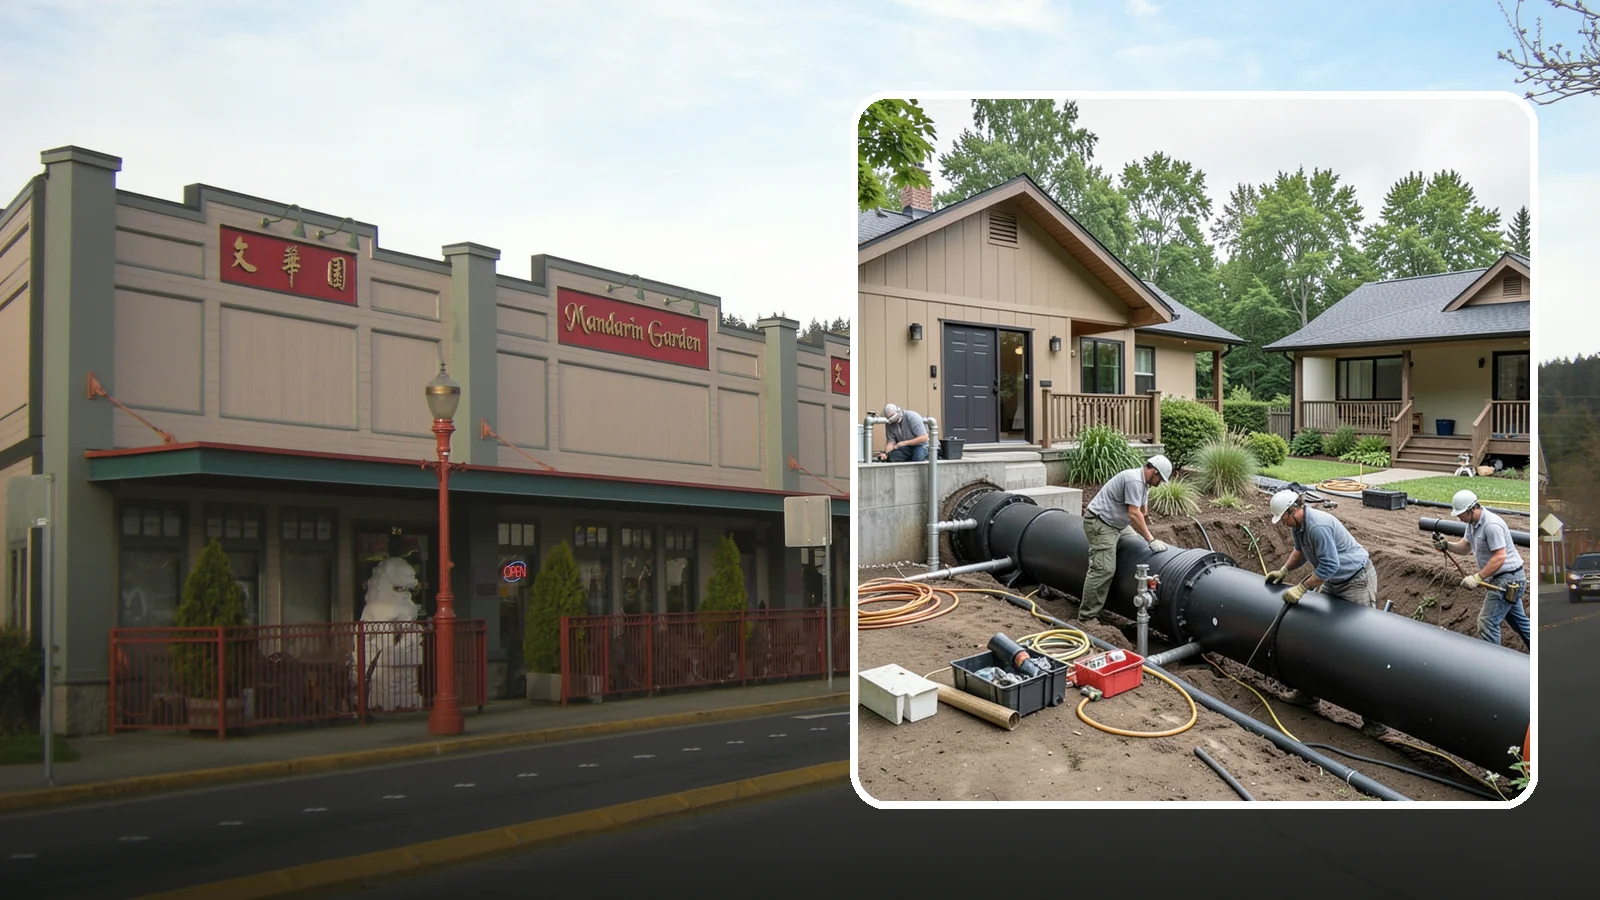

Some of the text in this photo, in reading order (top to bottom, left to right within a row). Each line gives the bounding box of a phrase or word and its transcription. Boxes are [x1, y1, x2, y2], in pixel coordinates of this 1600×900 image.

[231, 235, 346, 290] 文華園
[564, 302, 702, 352] Mandarin Garden
[503, 565, 527, 578] OPEN
